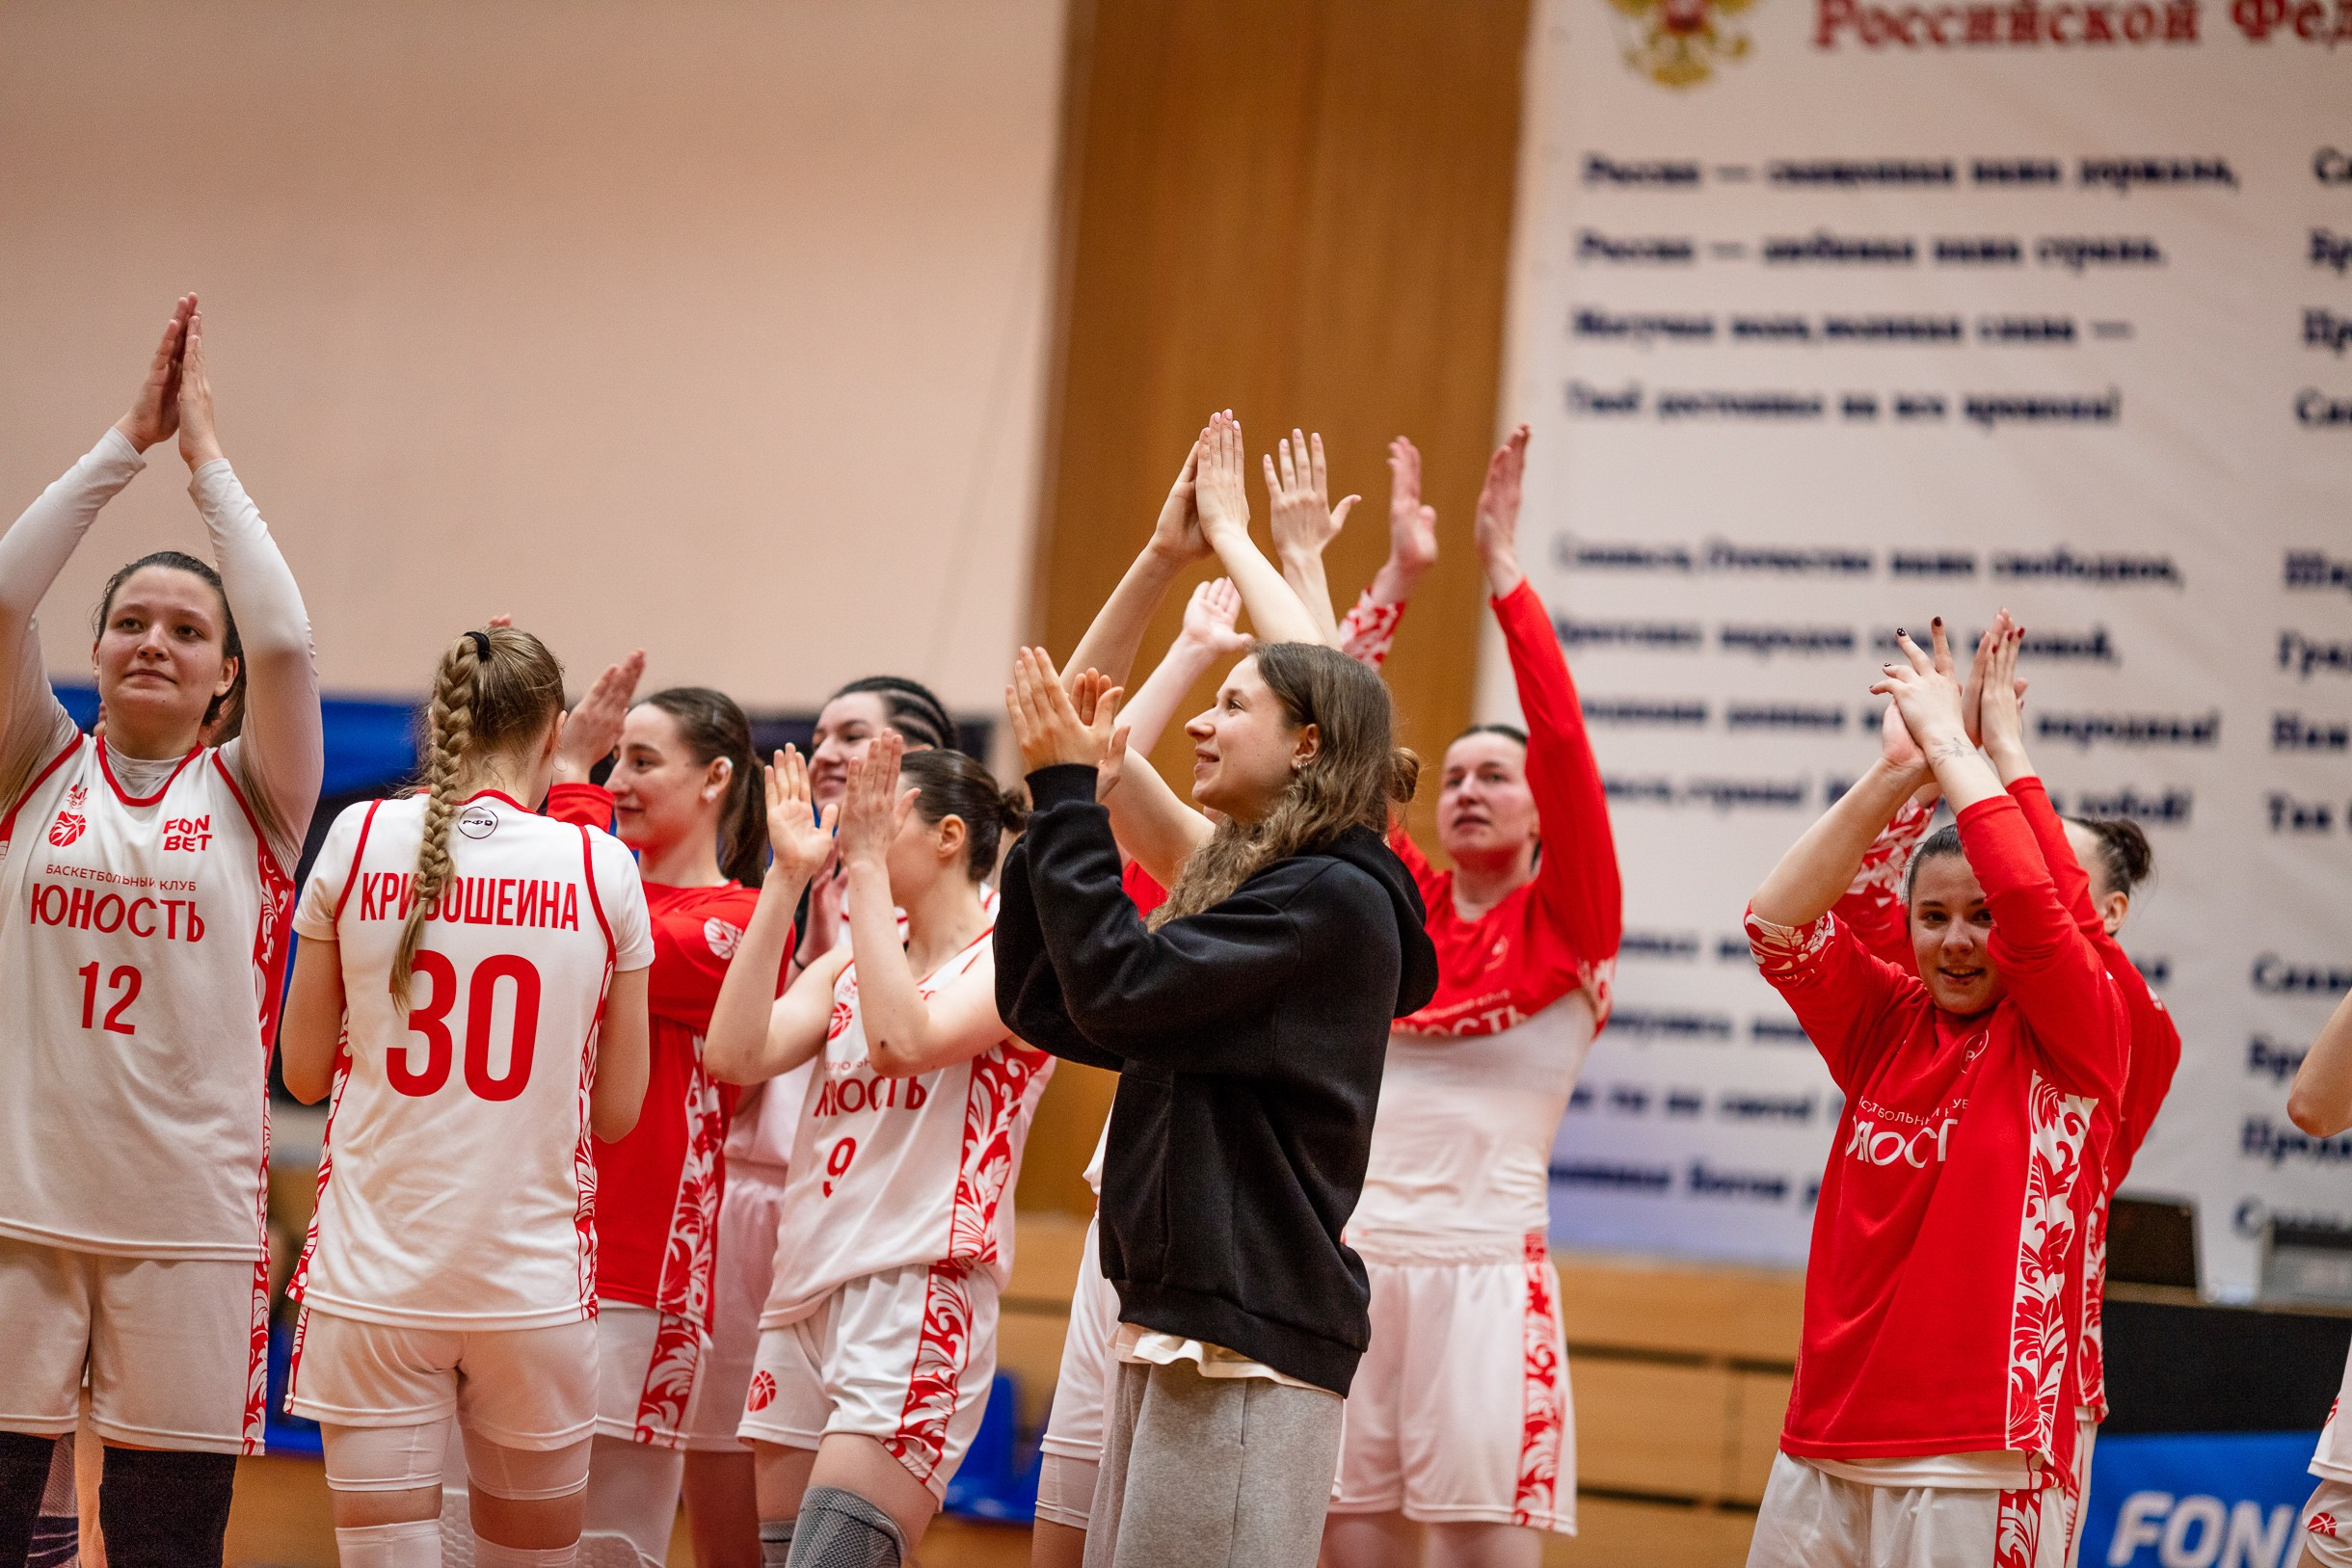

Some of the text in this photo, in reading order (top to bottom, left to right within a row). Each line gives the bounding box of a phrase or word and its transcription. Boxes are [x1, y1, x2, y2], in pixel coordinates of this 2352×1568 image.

[163, 814, 211, 836] FON
[163, 834, 213, 852] BET
[30, 883, 205, 943] ЮНОСТЬ
[159, 879, 197, 891] КЛУБ
[78, 961, 143, 1036] 12
[386, 949, 541, 1102] 30
[823, 1137, 857, 1198] 9
